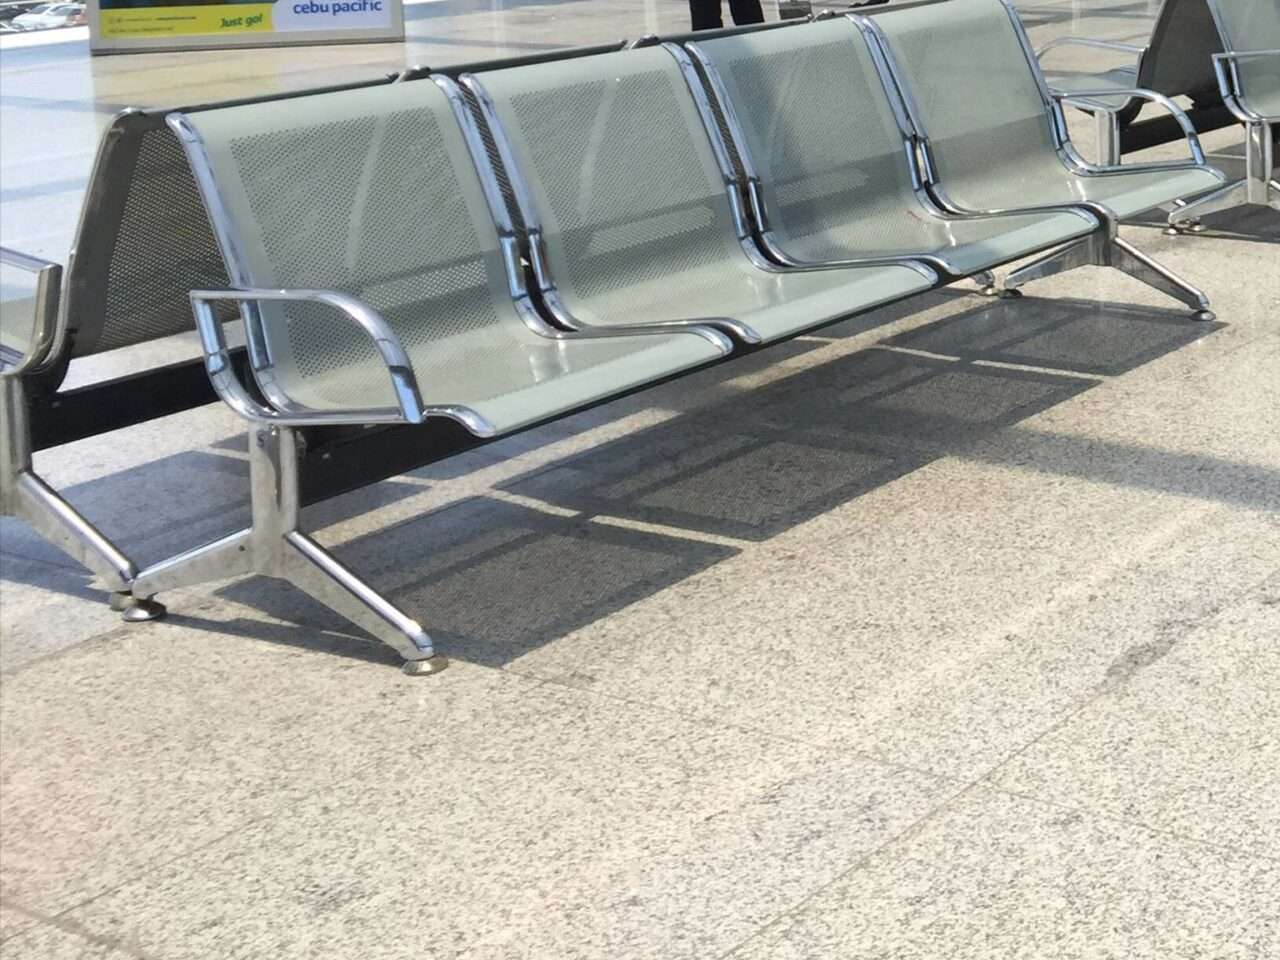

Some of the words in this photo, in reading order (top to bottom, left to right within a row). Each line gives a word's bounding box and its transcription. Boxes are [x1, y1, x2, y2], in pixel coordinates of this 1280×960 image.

[293, 0, 329, 14] cebu
[219, 17, 242, 28] Just
[245, 13, 263, 27] go!
